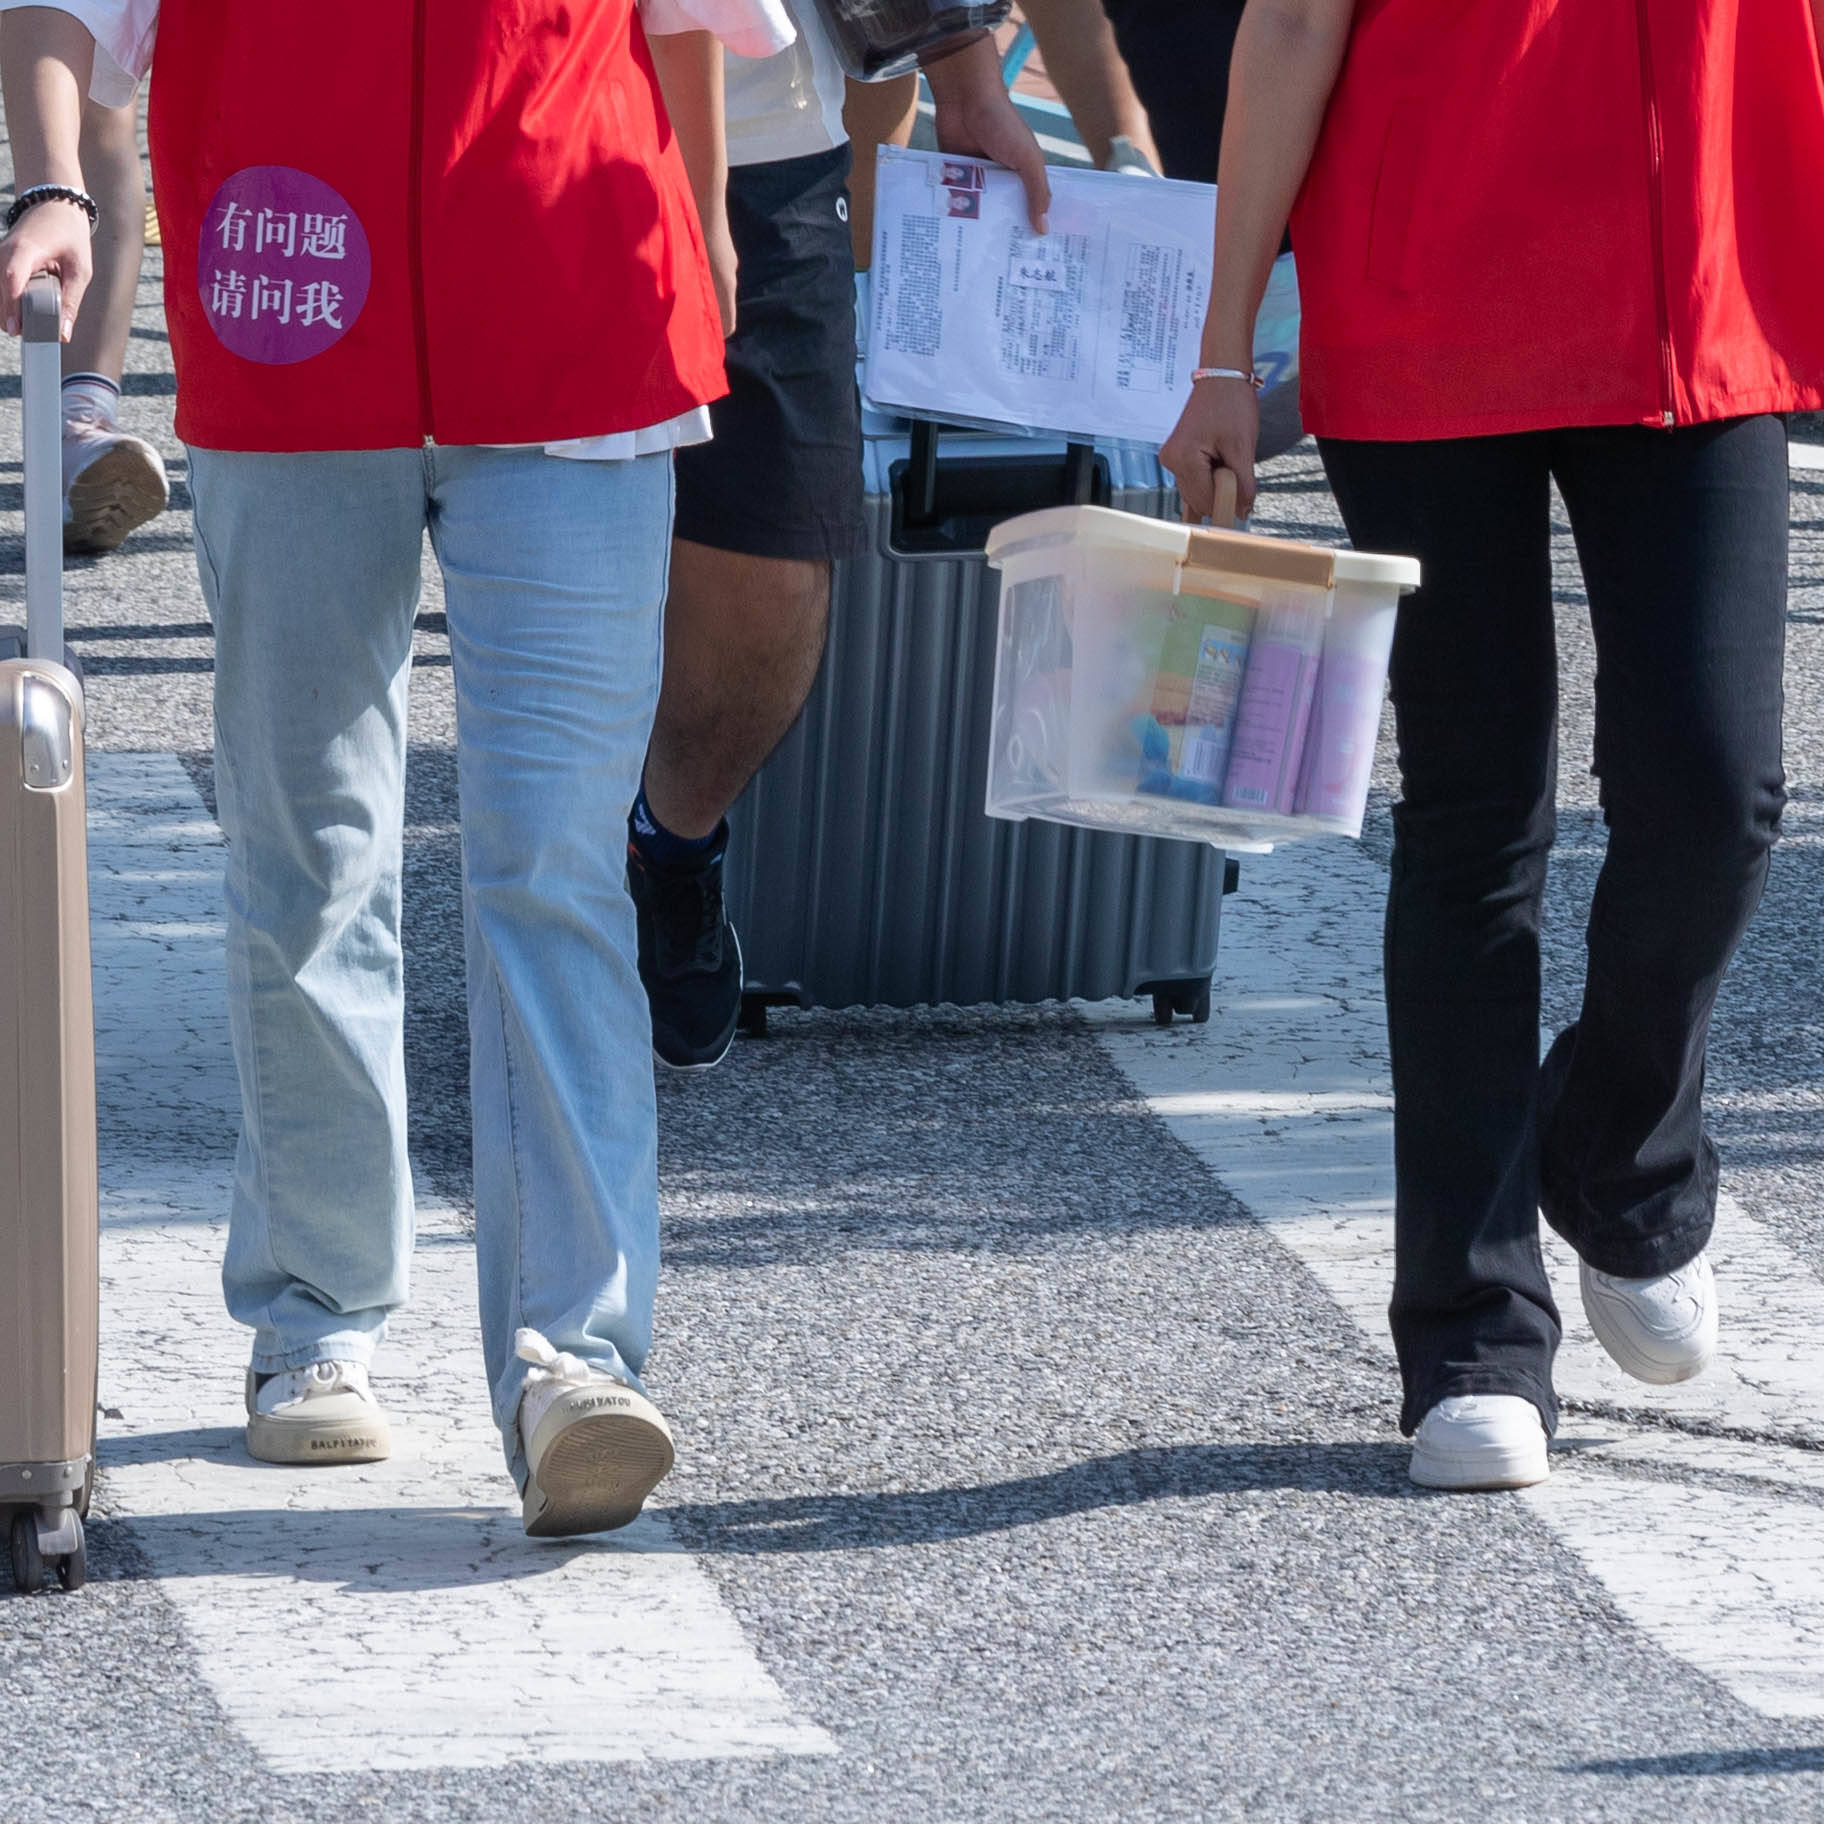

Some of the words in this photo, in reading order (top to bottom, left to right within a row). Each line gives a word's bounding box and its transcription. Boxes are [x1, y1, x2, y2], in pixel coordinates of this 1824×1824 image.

[216, 201, 348, 260] 有问题
[210, 269, 345, 329] 请问我
